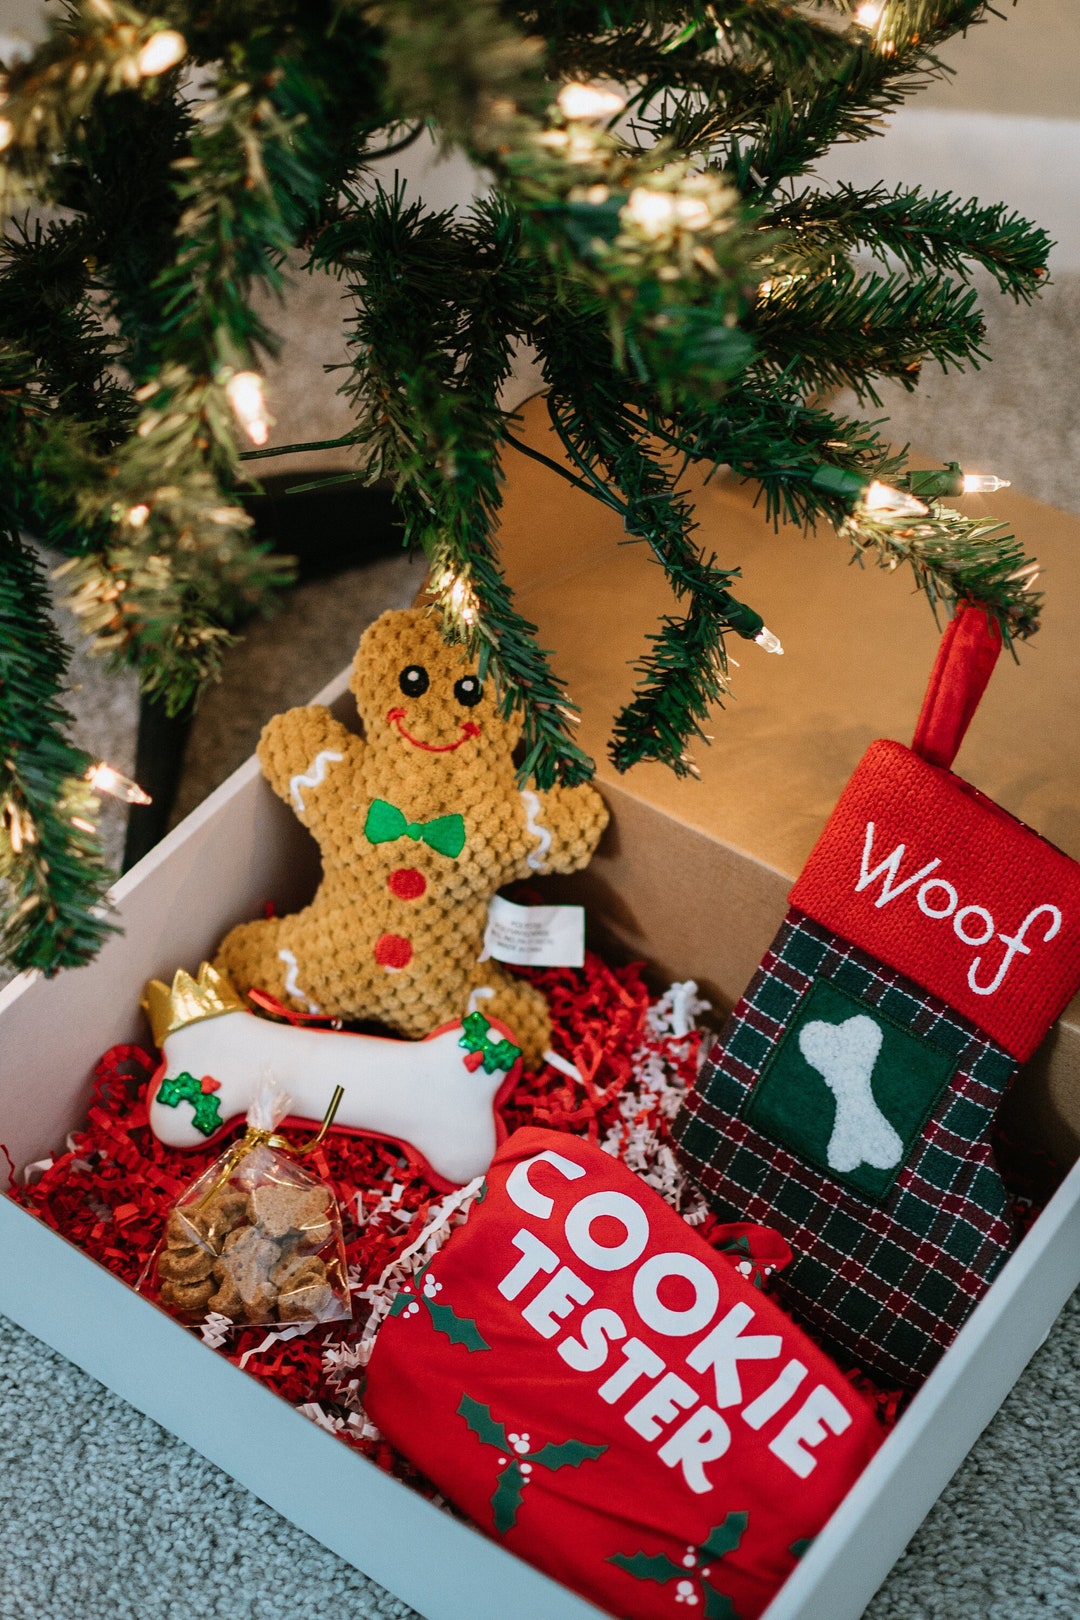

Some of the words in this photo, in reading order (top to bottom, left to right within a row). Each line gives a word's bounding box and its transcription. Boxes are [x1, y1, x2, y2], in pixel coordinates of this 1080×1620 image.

[855, 821, 1062, 996] Woof
[497, 1228, 731, 1494] TESTER
[506, 1150, 852, 1478] COOKIE
